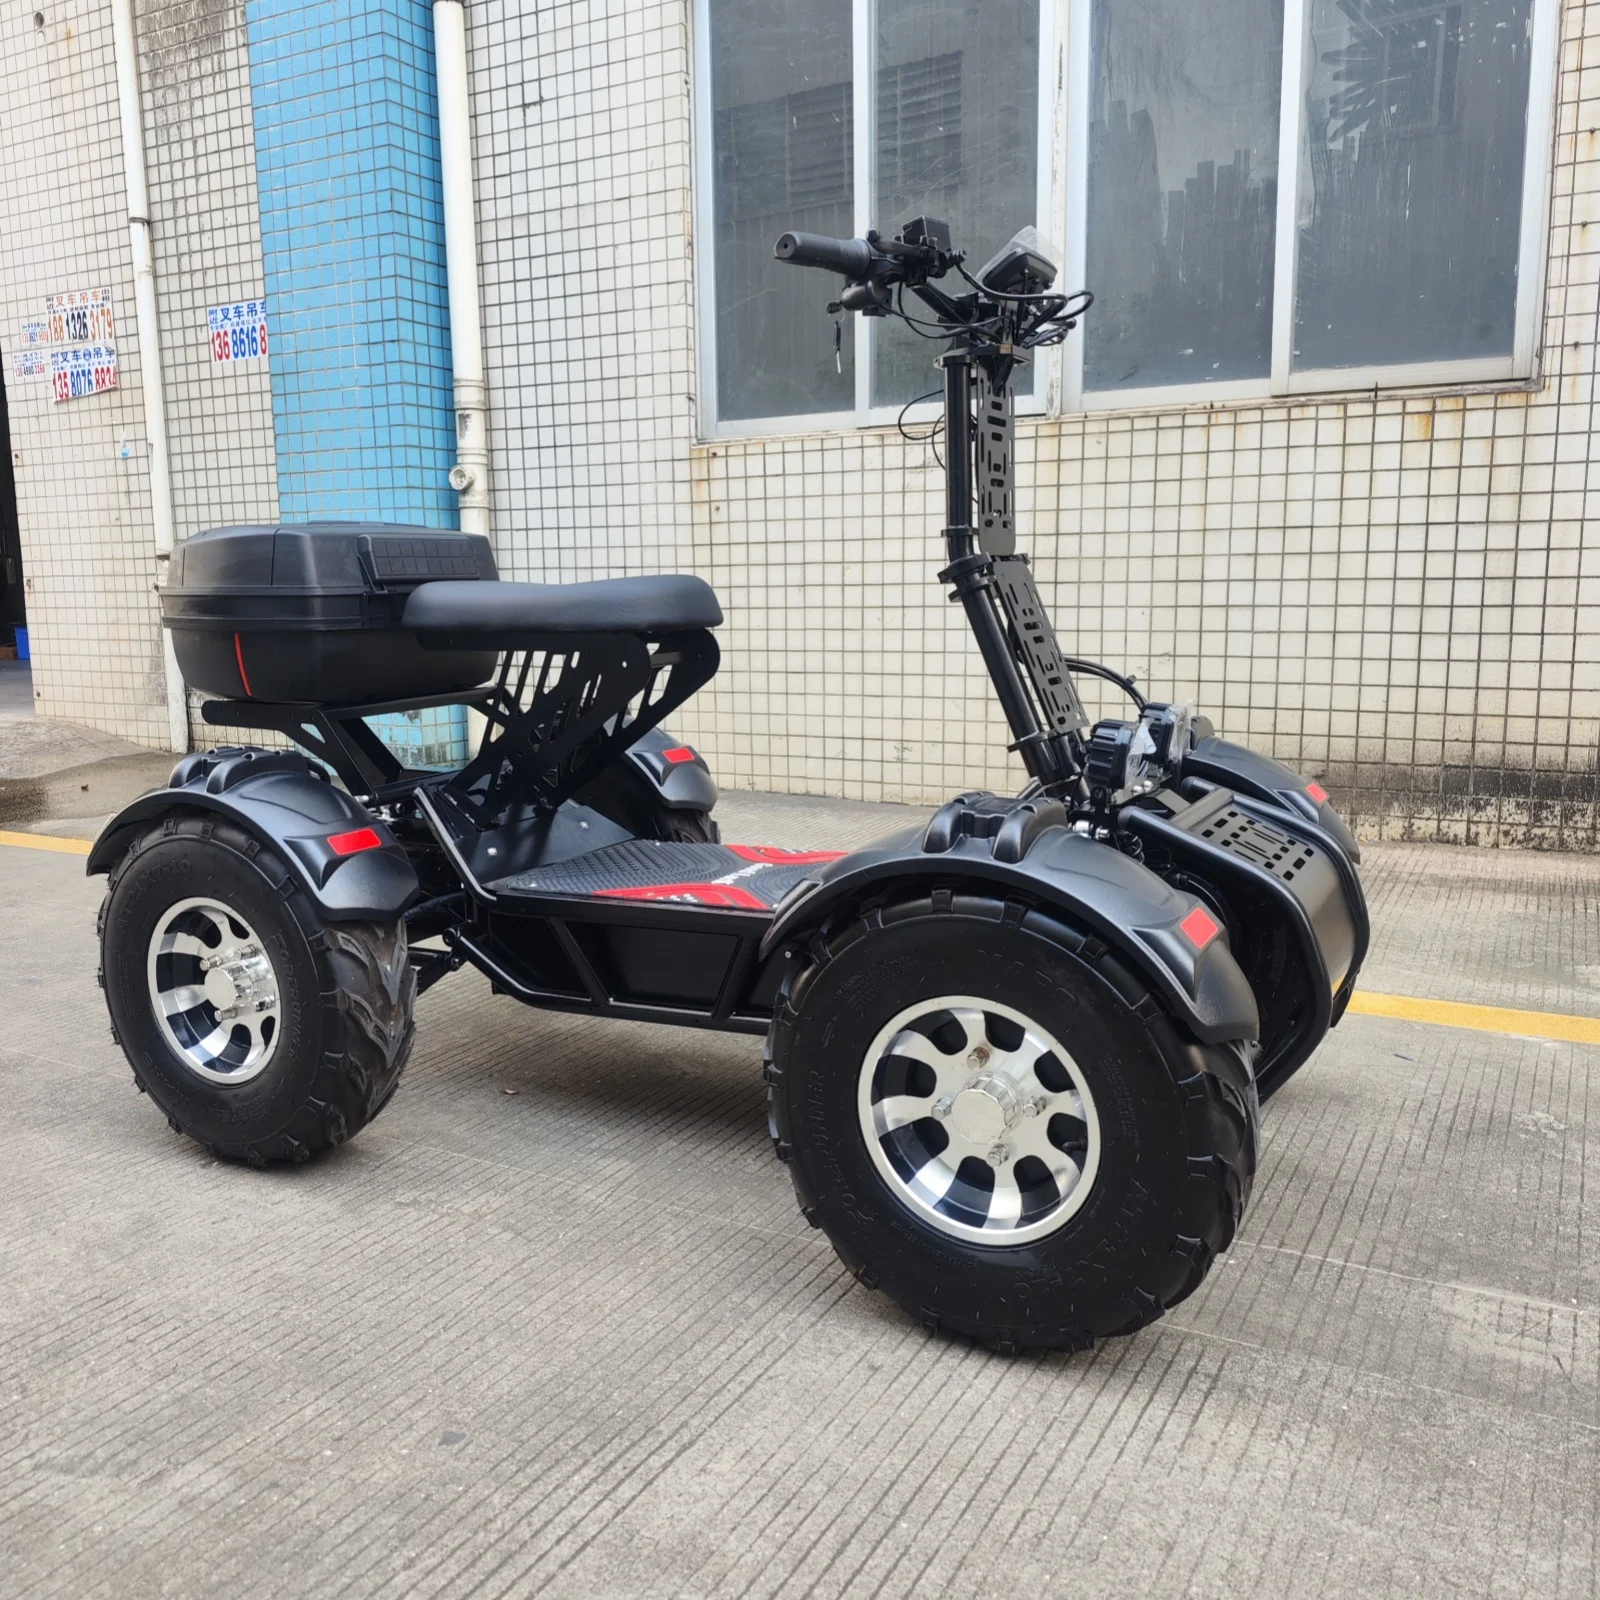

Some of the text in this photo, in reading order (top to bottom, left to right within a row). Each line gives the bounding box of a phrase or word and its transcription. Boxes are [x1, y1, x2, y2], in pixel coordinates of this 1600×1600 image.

[56, 290, 101, 307] 叉车吊车
[48, 314, 64, 343] 188
[66, 310, 89, 340] 1326
[90, 308, 113, 341] 3179
[211, 324, 267, 362] 136 8616 8
[53, 371, 70, 400] 135
[70, 367, 94, 397] 8076
